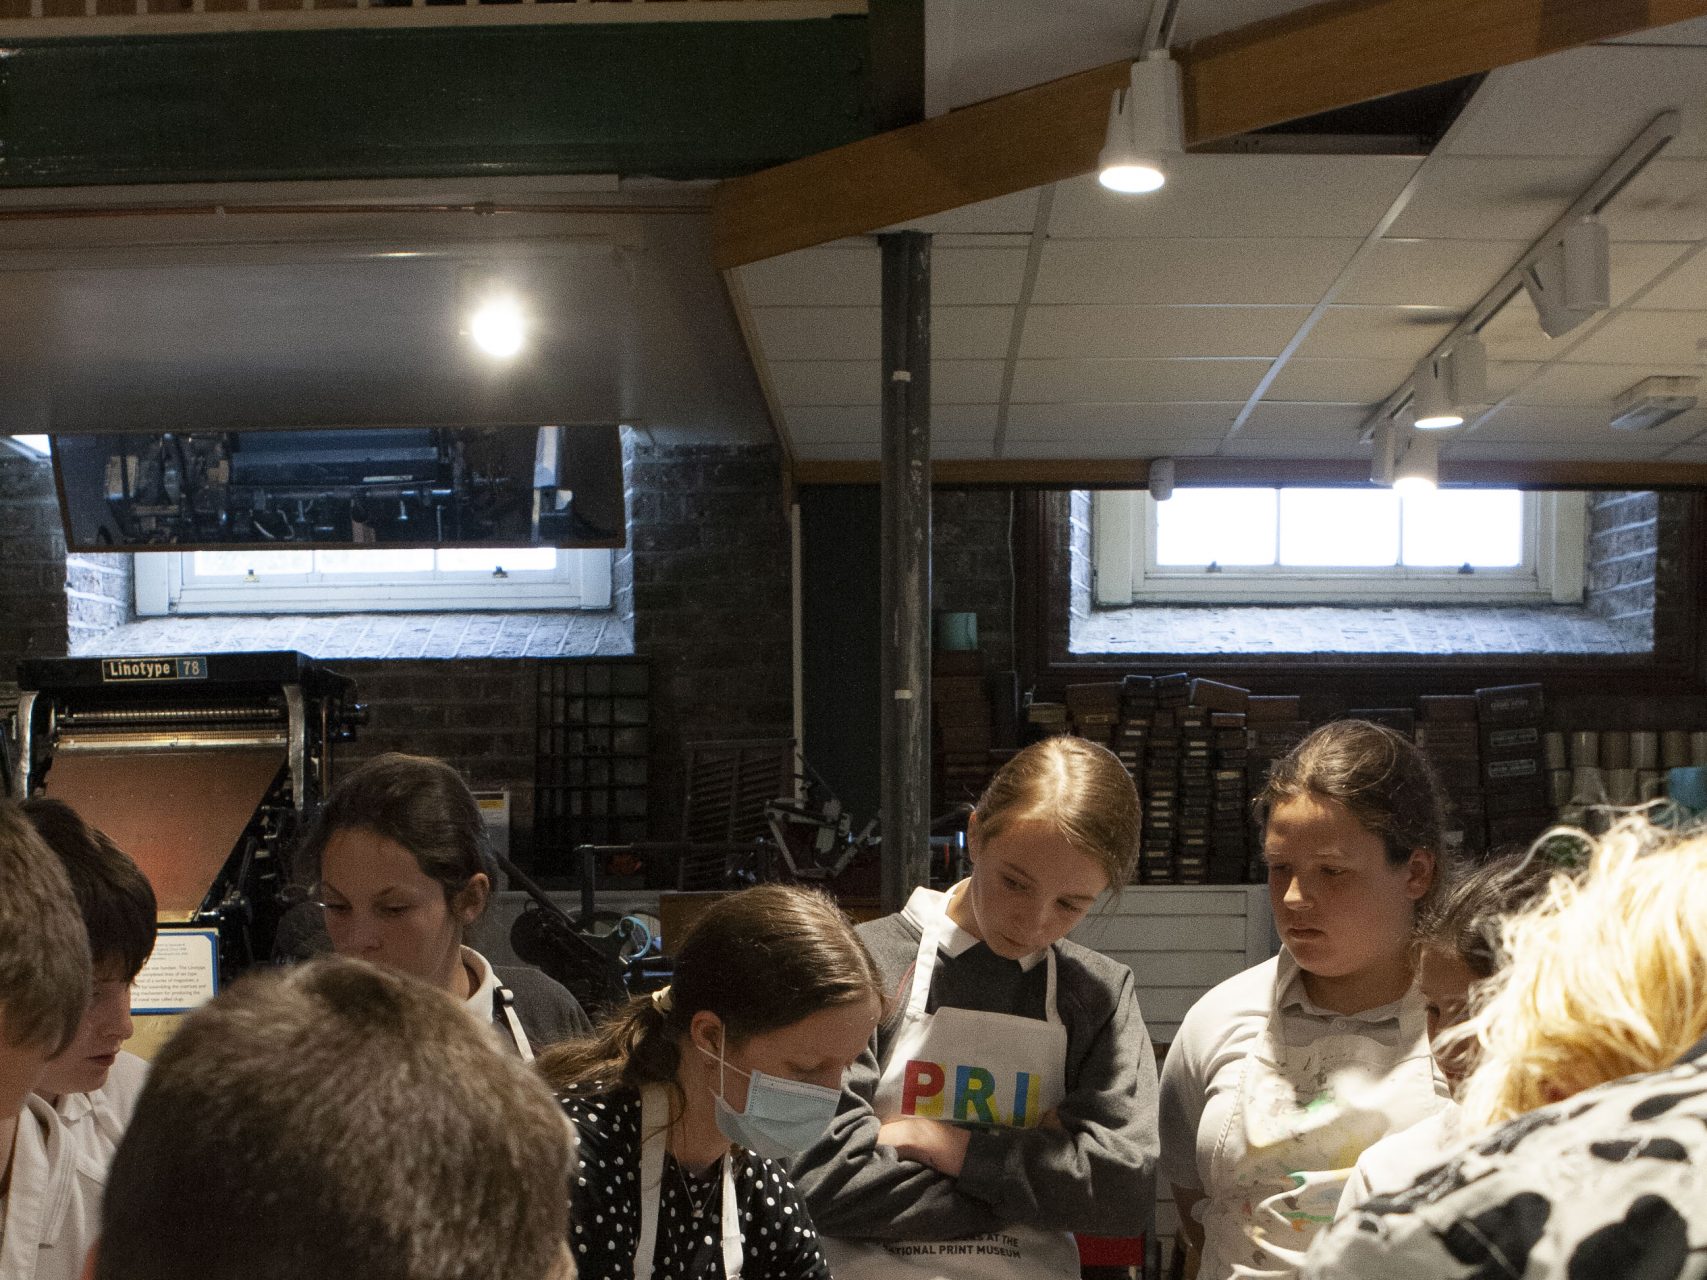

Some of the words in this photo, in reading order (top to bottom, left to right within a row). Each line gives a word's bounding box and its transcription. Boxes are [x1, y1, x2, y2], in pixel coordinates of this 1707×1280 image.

[110, 661, 170, 678] Linotype
[183, 660, 200, 676] 78
[901, 1060, 1040, 1127] PRI
[1002, 1235, 1019, 1247] THE
[939, 1245, 974, 1255] PRINT
[976, 1246, 1021, 1258] MUSEUM
